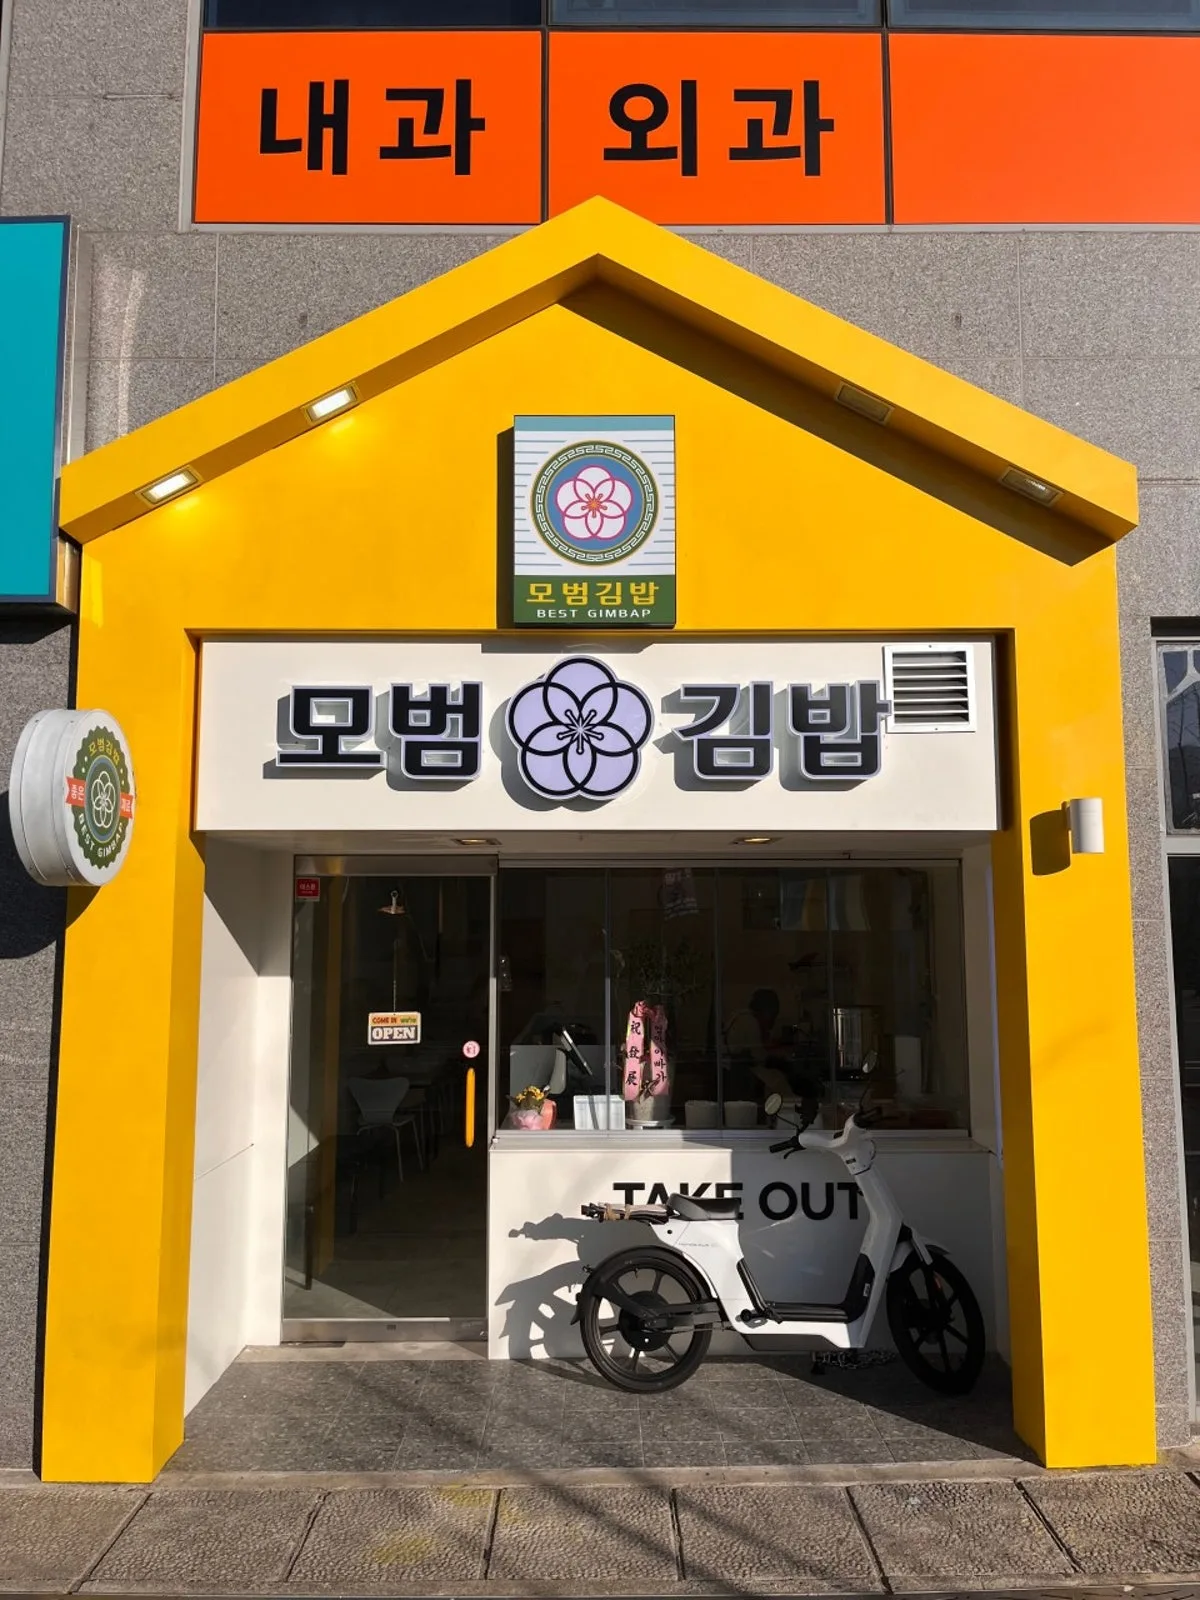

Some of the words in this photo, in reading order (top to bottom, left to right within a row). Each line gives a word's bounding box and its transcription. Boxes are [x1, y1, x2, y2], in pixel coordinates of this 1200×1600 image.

[259, 78, 486, 176] 내과
[603, 79, 835, 177] 외과
[526, 581, 660, 606] 모범김밥
[536, 608, 579, 618] BEST
[587, 608, 652, 618] GIMBAP
[276, 681, 484, 781] 모범
[671, 680, 893, 781] 김밥
[89, 737, 120, 765] 모범김밥
[78, 813, 96, 851] BEST
[97, 822, 124, 857] GIMBAP
[372, 1016, 390, 1024] COME
[372, 1026, 416, 1040] OPEN
[758, 1181, 864, 1221] OUT
